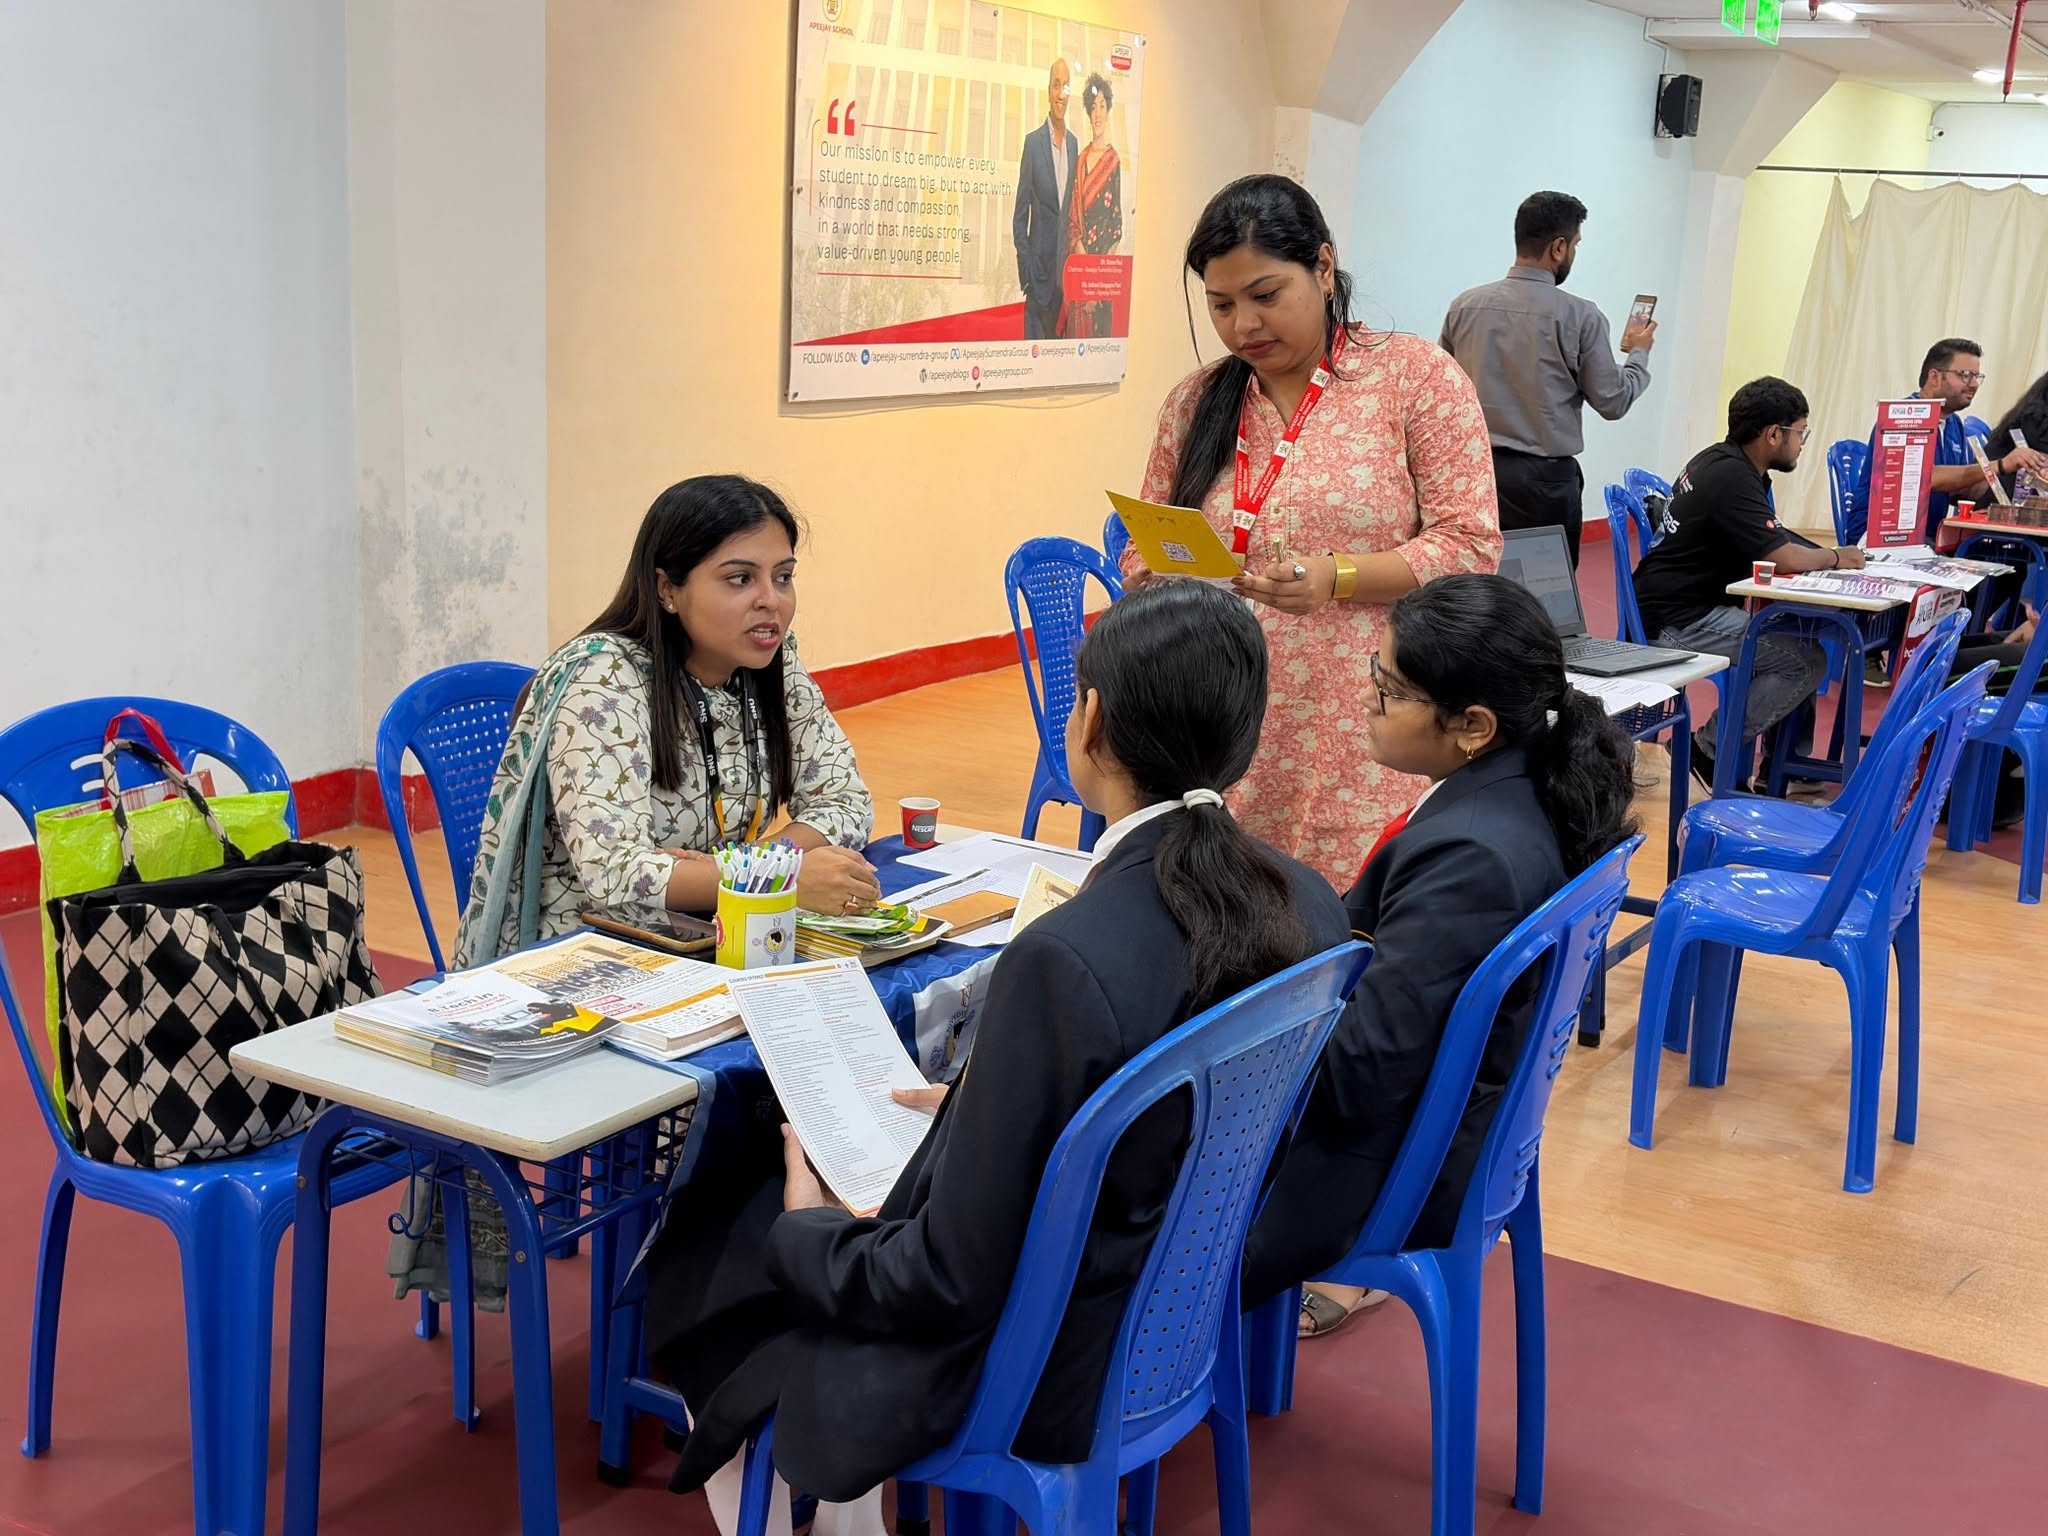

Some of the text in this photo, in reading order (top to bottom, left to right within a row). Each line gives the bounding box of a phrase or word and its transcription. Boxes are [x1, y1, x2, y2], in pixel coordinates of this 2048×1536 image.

[809, 22, 854, 36] APEEJAY SCHOOL
[820, 140, 841, 157] Our
[844, 144, 888, 162] mission
[892, 147, 901, 164] is
[904, 150, 915, 165] to
[918, 153, 966, 170] empower
[819, 167, 865, 185] student
[867, 171, 879, 186] to
[882, 171, 917, 190] dream
[940, 177, 957, 193] but
[960, 181, 970, 194] to
[973, 181, 989, 195] act
[991, 181, 1011, 196] with
[818, 192, 870, 211] kindness
[873, 196, 894, 213] and
[818, 217, 828, 233] in
[832, 221, 839, 234] a
[842, 219, 874, 236] world
[877, 221, 900, 237] that
[902, 223, 934, 239] needs
[817, 244, 962, 265] value-driven young people.
[803, 352, 832, 364] FOLLOW
[834, 351, 844, 363] US
[845, 351, 857, 363] ON:
[1288, 392, 1312, 433] APEEJAY SCHOOL
[1251, 464, 1276, 504] APEEJAY SCHOOL
[698, 701, 707, 723] SNU
[748, 698, 757, 719] SNU
[707, 754, 716, 776] SNU
[911, 824, 935, 833] NESCAF
